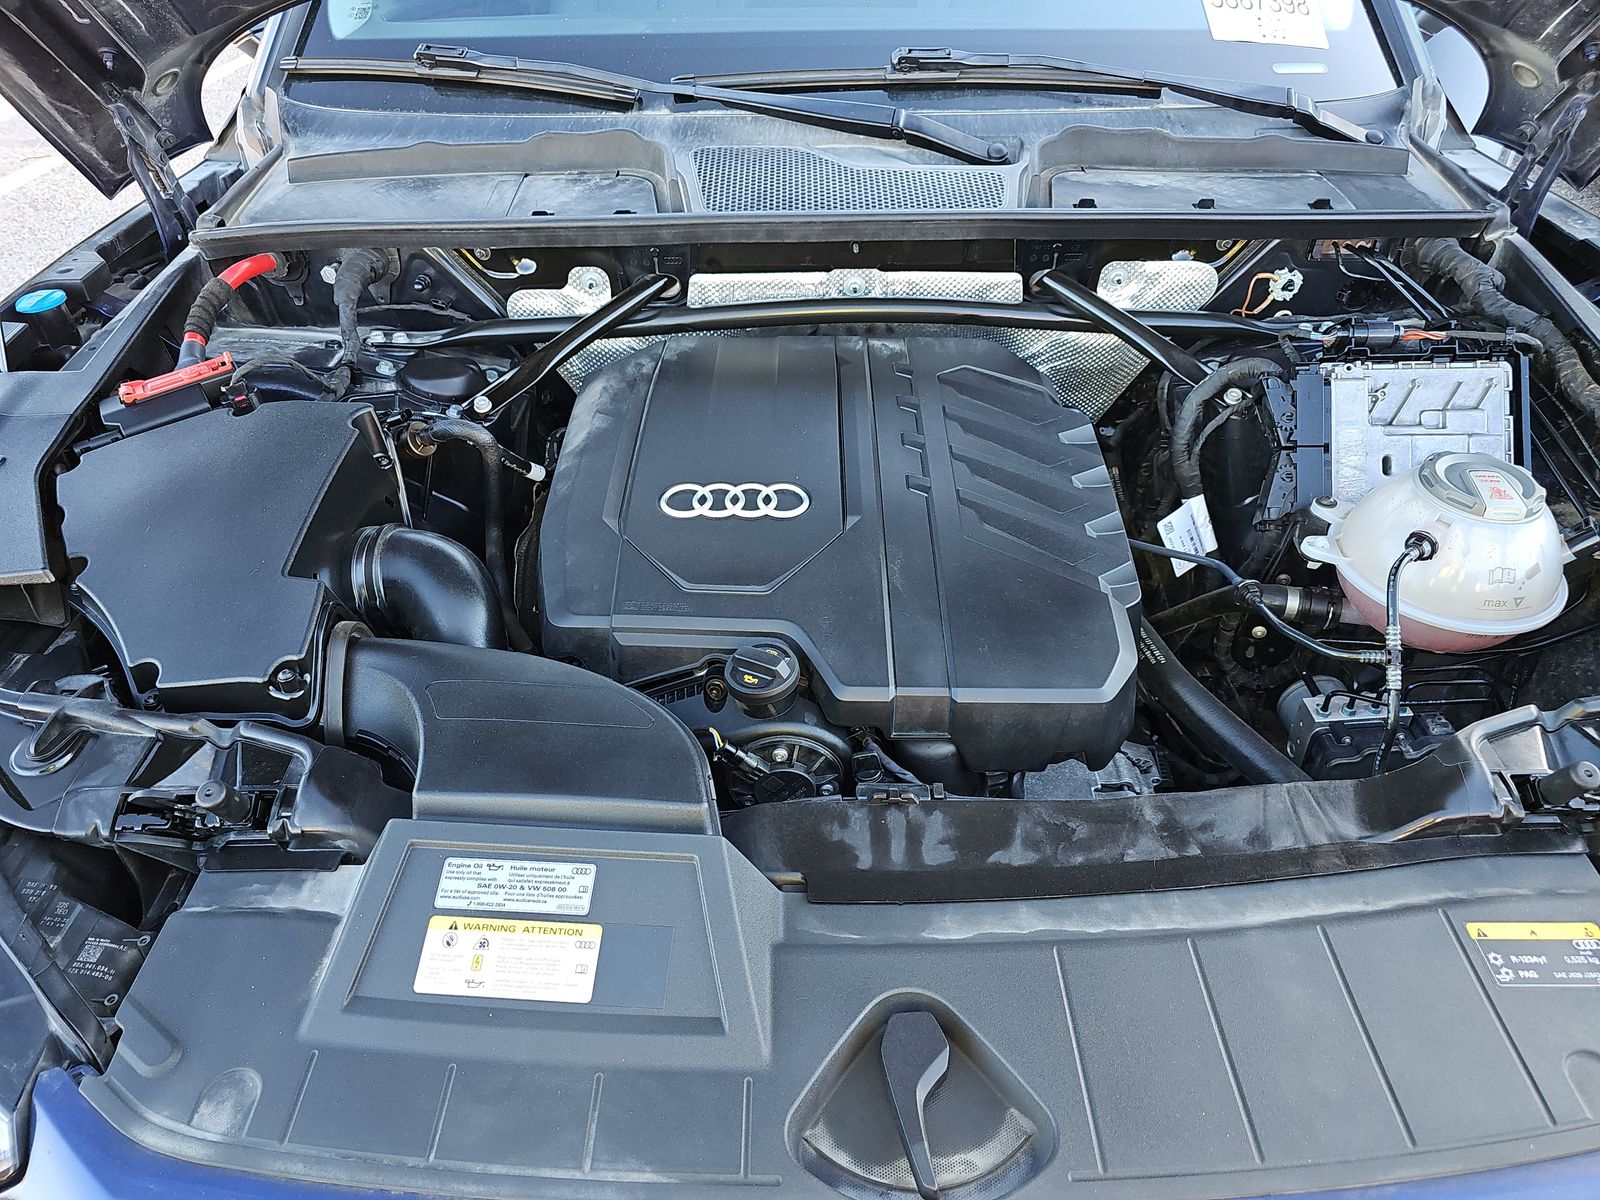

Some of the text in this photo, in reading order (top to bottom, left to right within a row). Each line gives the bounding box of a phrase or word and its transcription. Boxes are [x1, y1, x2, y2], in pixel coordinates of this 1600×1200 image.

[1483, 599, 1509, 608] max
[463, 922, 584, 937] WARNING ATTENTION
